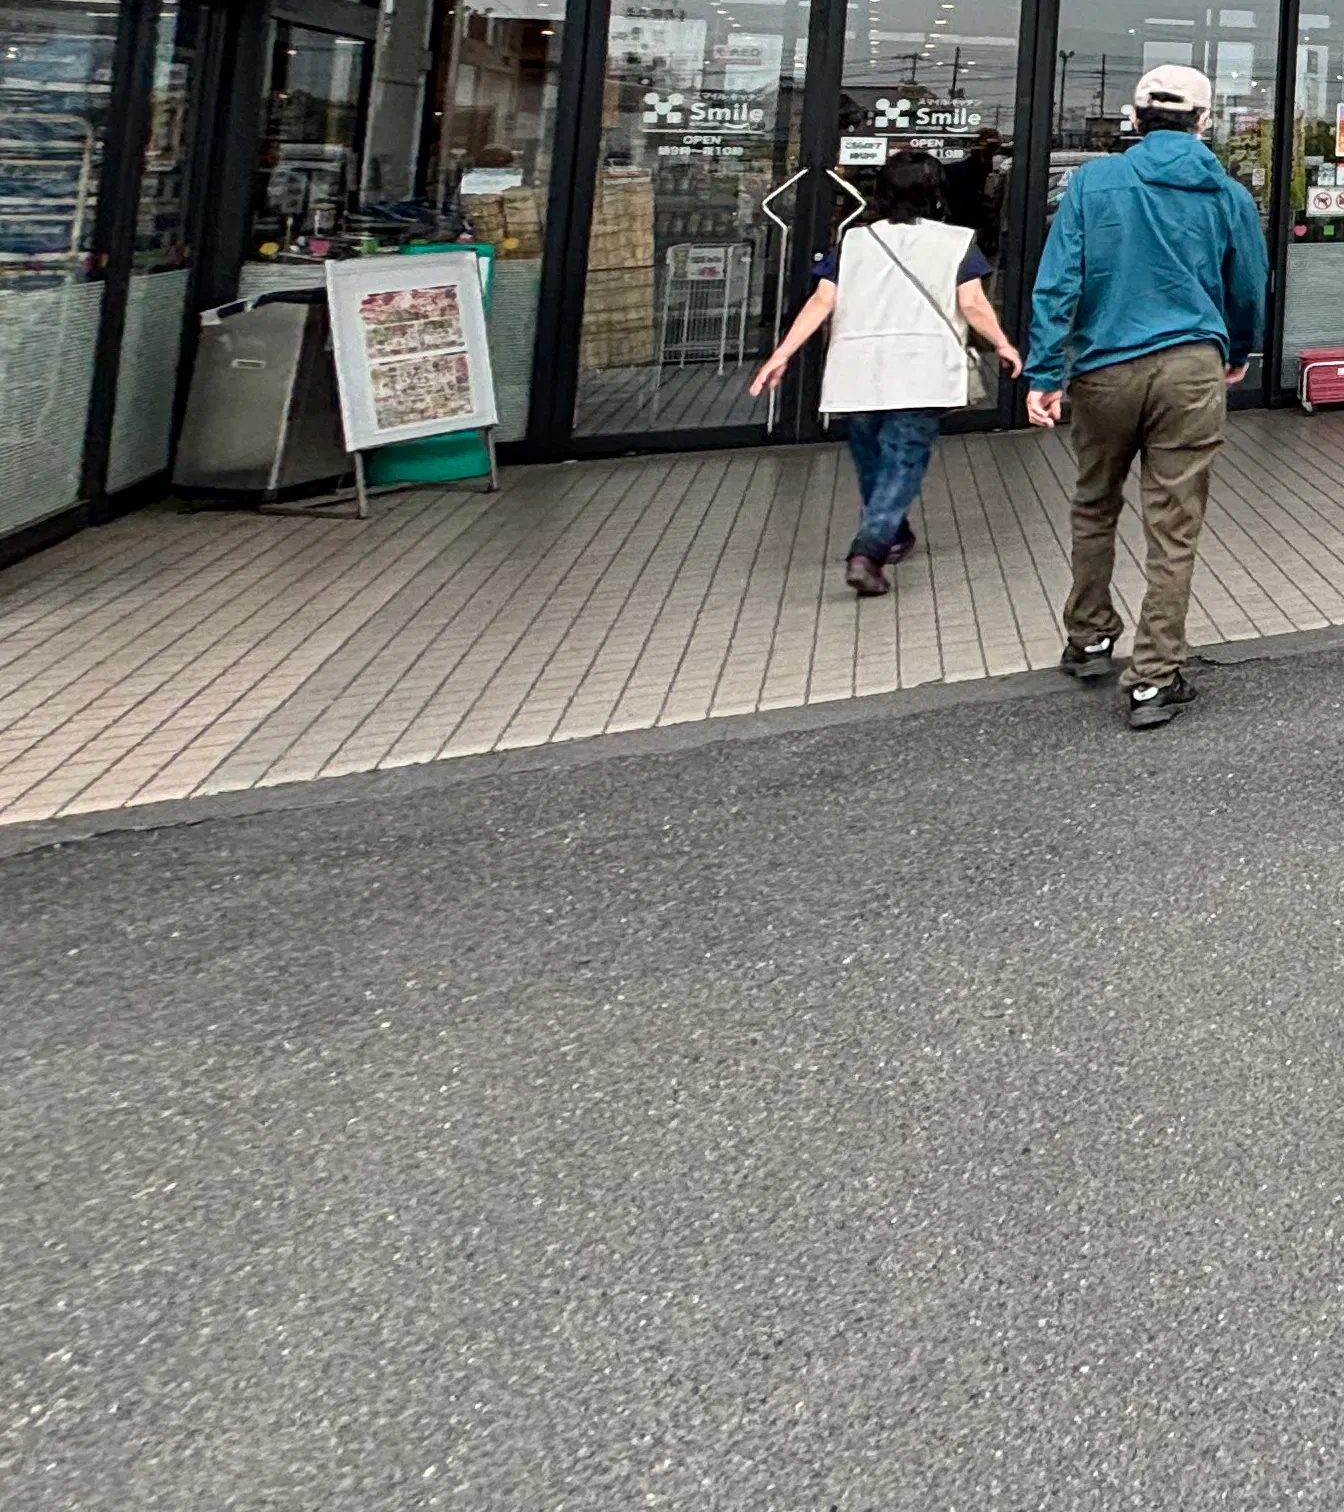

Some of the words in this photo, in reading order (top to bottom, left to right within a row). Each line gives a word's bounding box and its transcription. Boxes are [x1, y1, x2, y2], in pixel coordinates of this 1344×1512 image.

[690, 102, 764, 122] Smile
[915, 107, 982, 126] Smile
[683, 135, 722, 145] OPEN
[909, 138, 944, 148] OPEN
